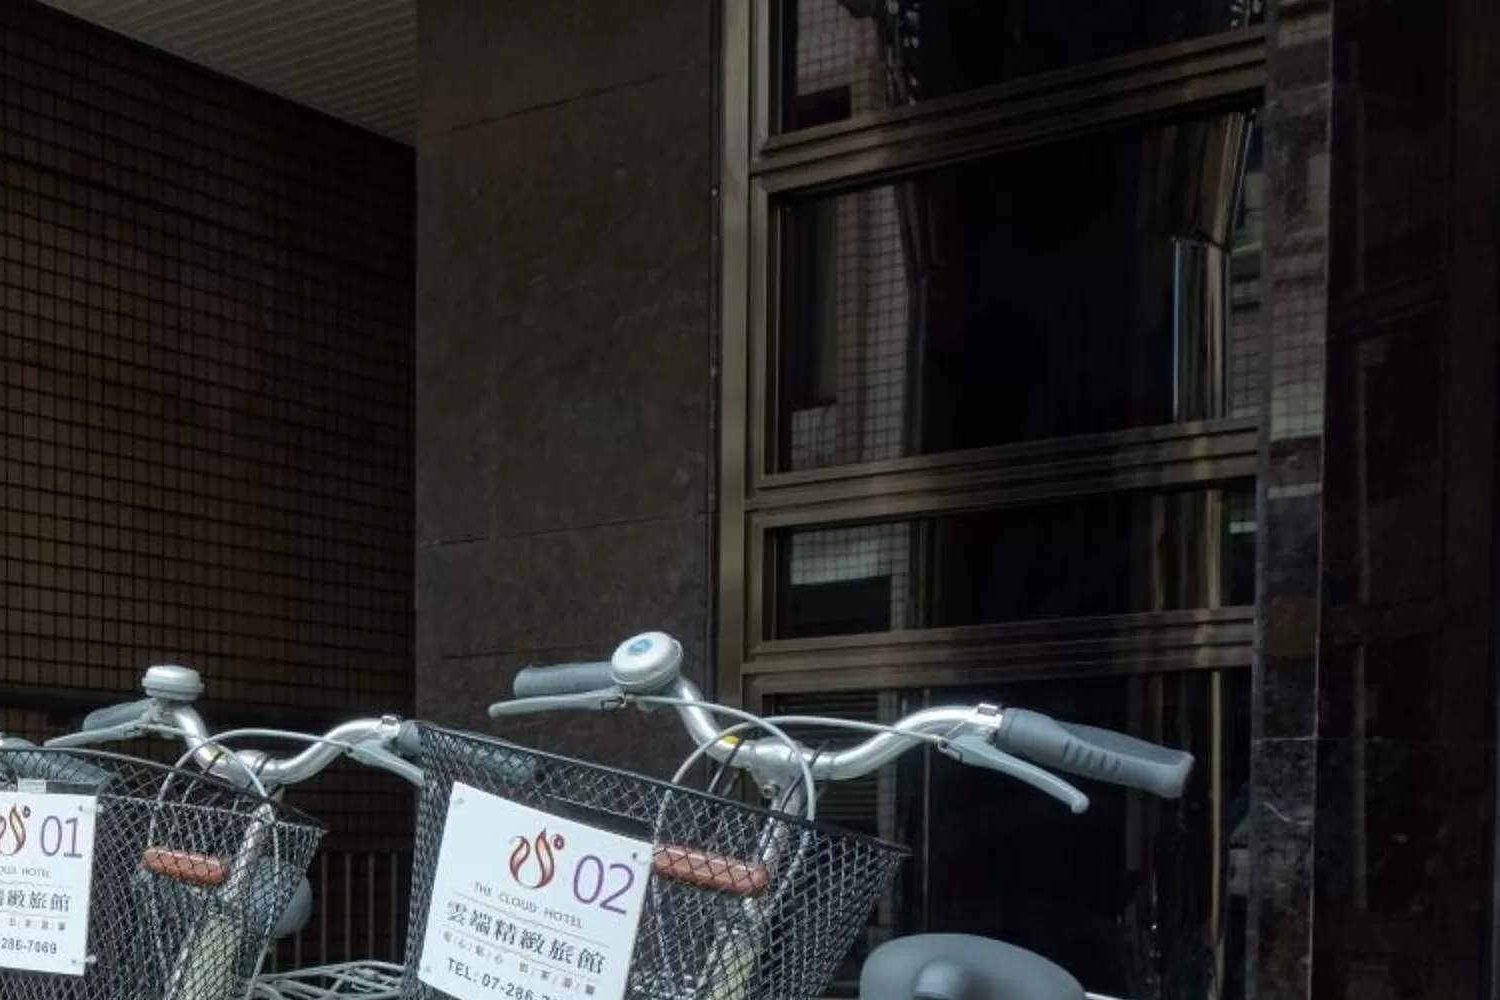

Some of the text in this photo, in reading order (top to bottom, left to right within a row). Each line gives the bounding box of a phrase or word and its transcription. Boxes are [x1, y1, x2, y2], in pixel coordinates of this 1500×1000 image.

[39, 815, 83, 859] 01
[474, 881, 585, 930] THE CLOUD HOTEL
[573, 855, 635, 915] 02
